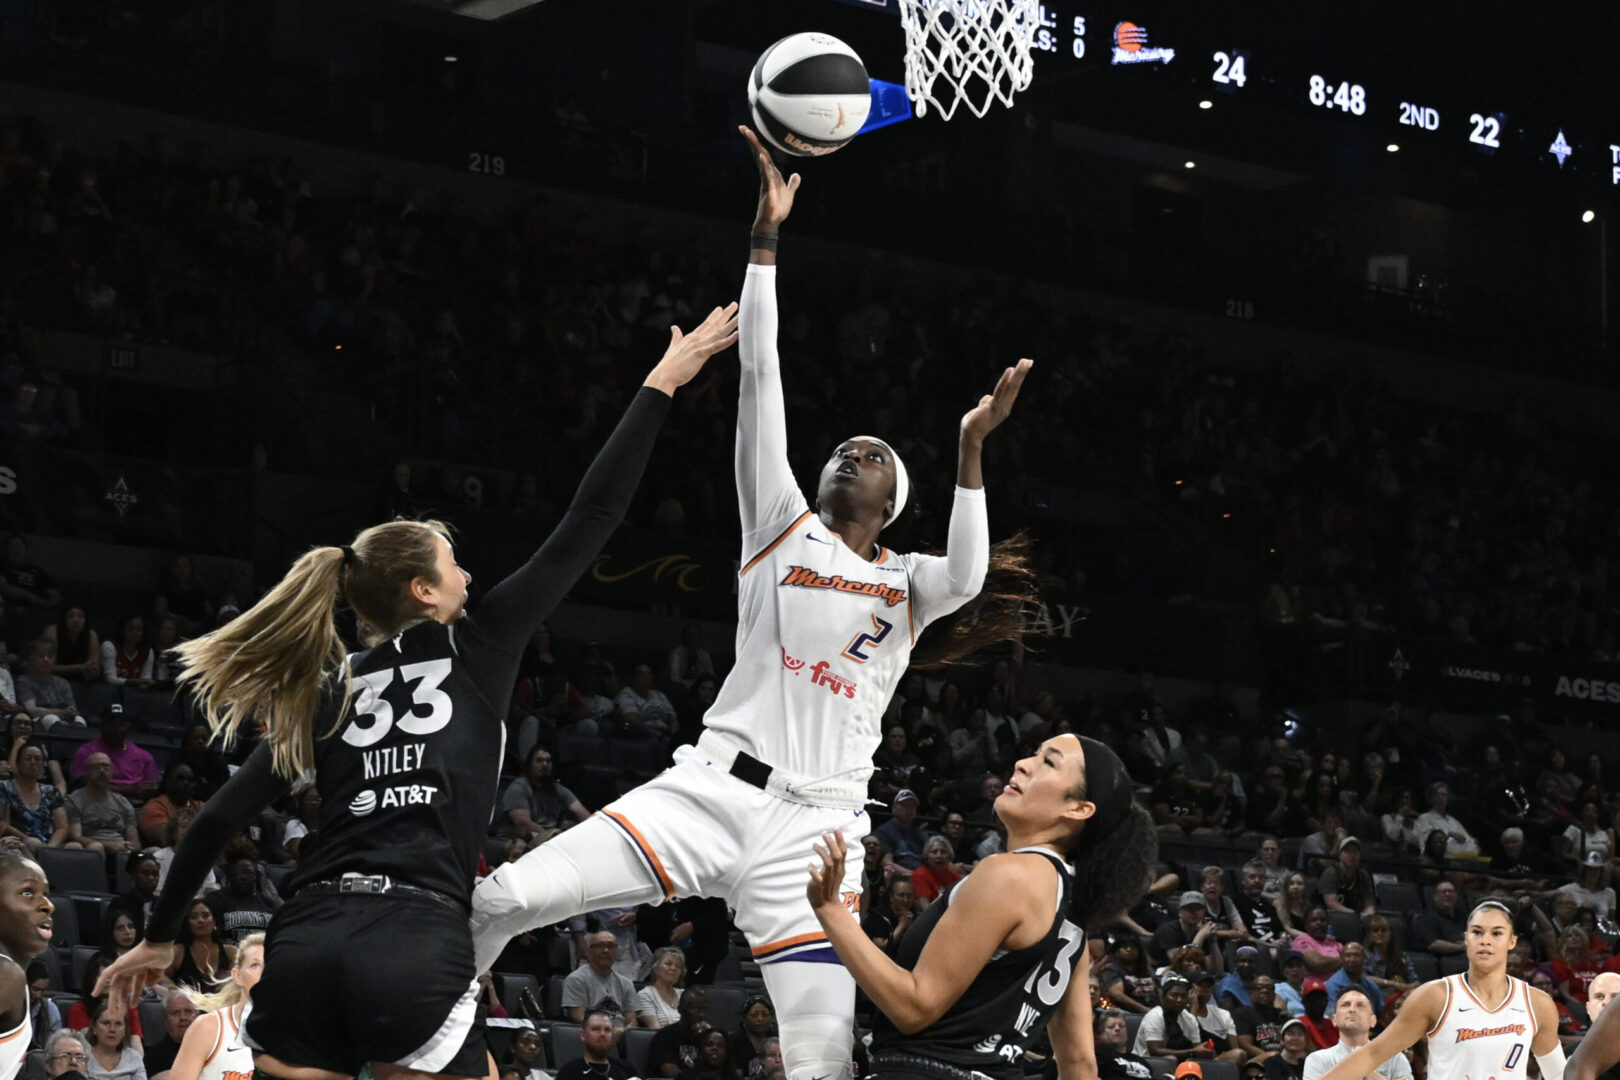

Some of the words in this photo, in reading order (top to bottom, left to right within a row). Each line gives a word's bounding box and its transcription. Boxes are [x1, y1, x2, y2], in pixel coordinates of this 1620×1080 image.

[1073, 16, 1085, 36] 5
[1073, 38, 1085, 59] 0
[1212, 51, 1247, 88] 24
[1309, 74, 1366, 116] 8:48
[1399, 102, 1440, 131] 2ND
[1469, 113, 1500, 148] 22
[469, 152, 505, 176] 219
[779, 565, 908, 608] Mercury
[841, 613, 893, 664] 2
[341, 658, 453, 748] 33
[1554, 675, 1620, 704] ACES
[362, 743, 426, 780] KITLEY
[381, 784, 438, 808] AT&T
[1455, 1024, 1526, 1043] Mercury
[1502, 1043, 1525, 1072] 0
